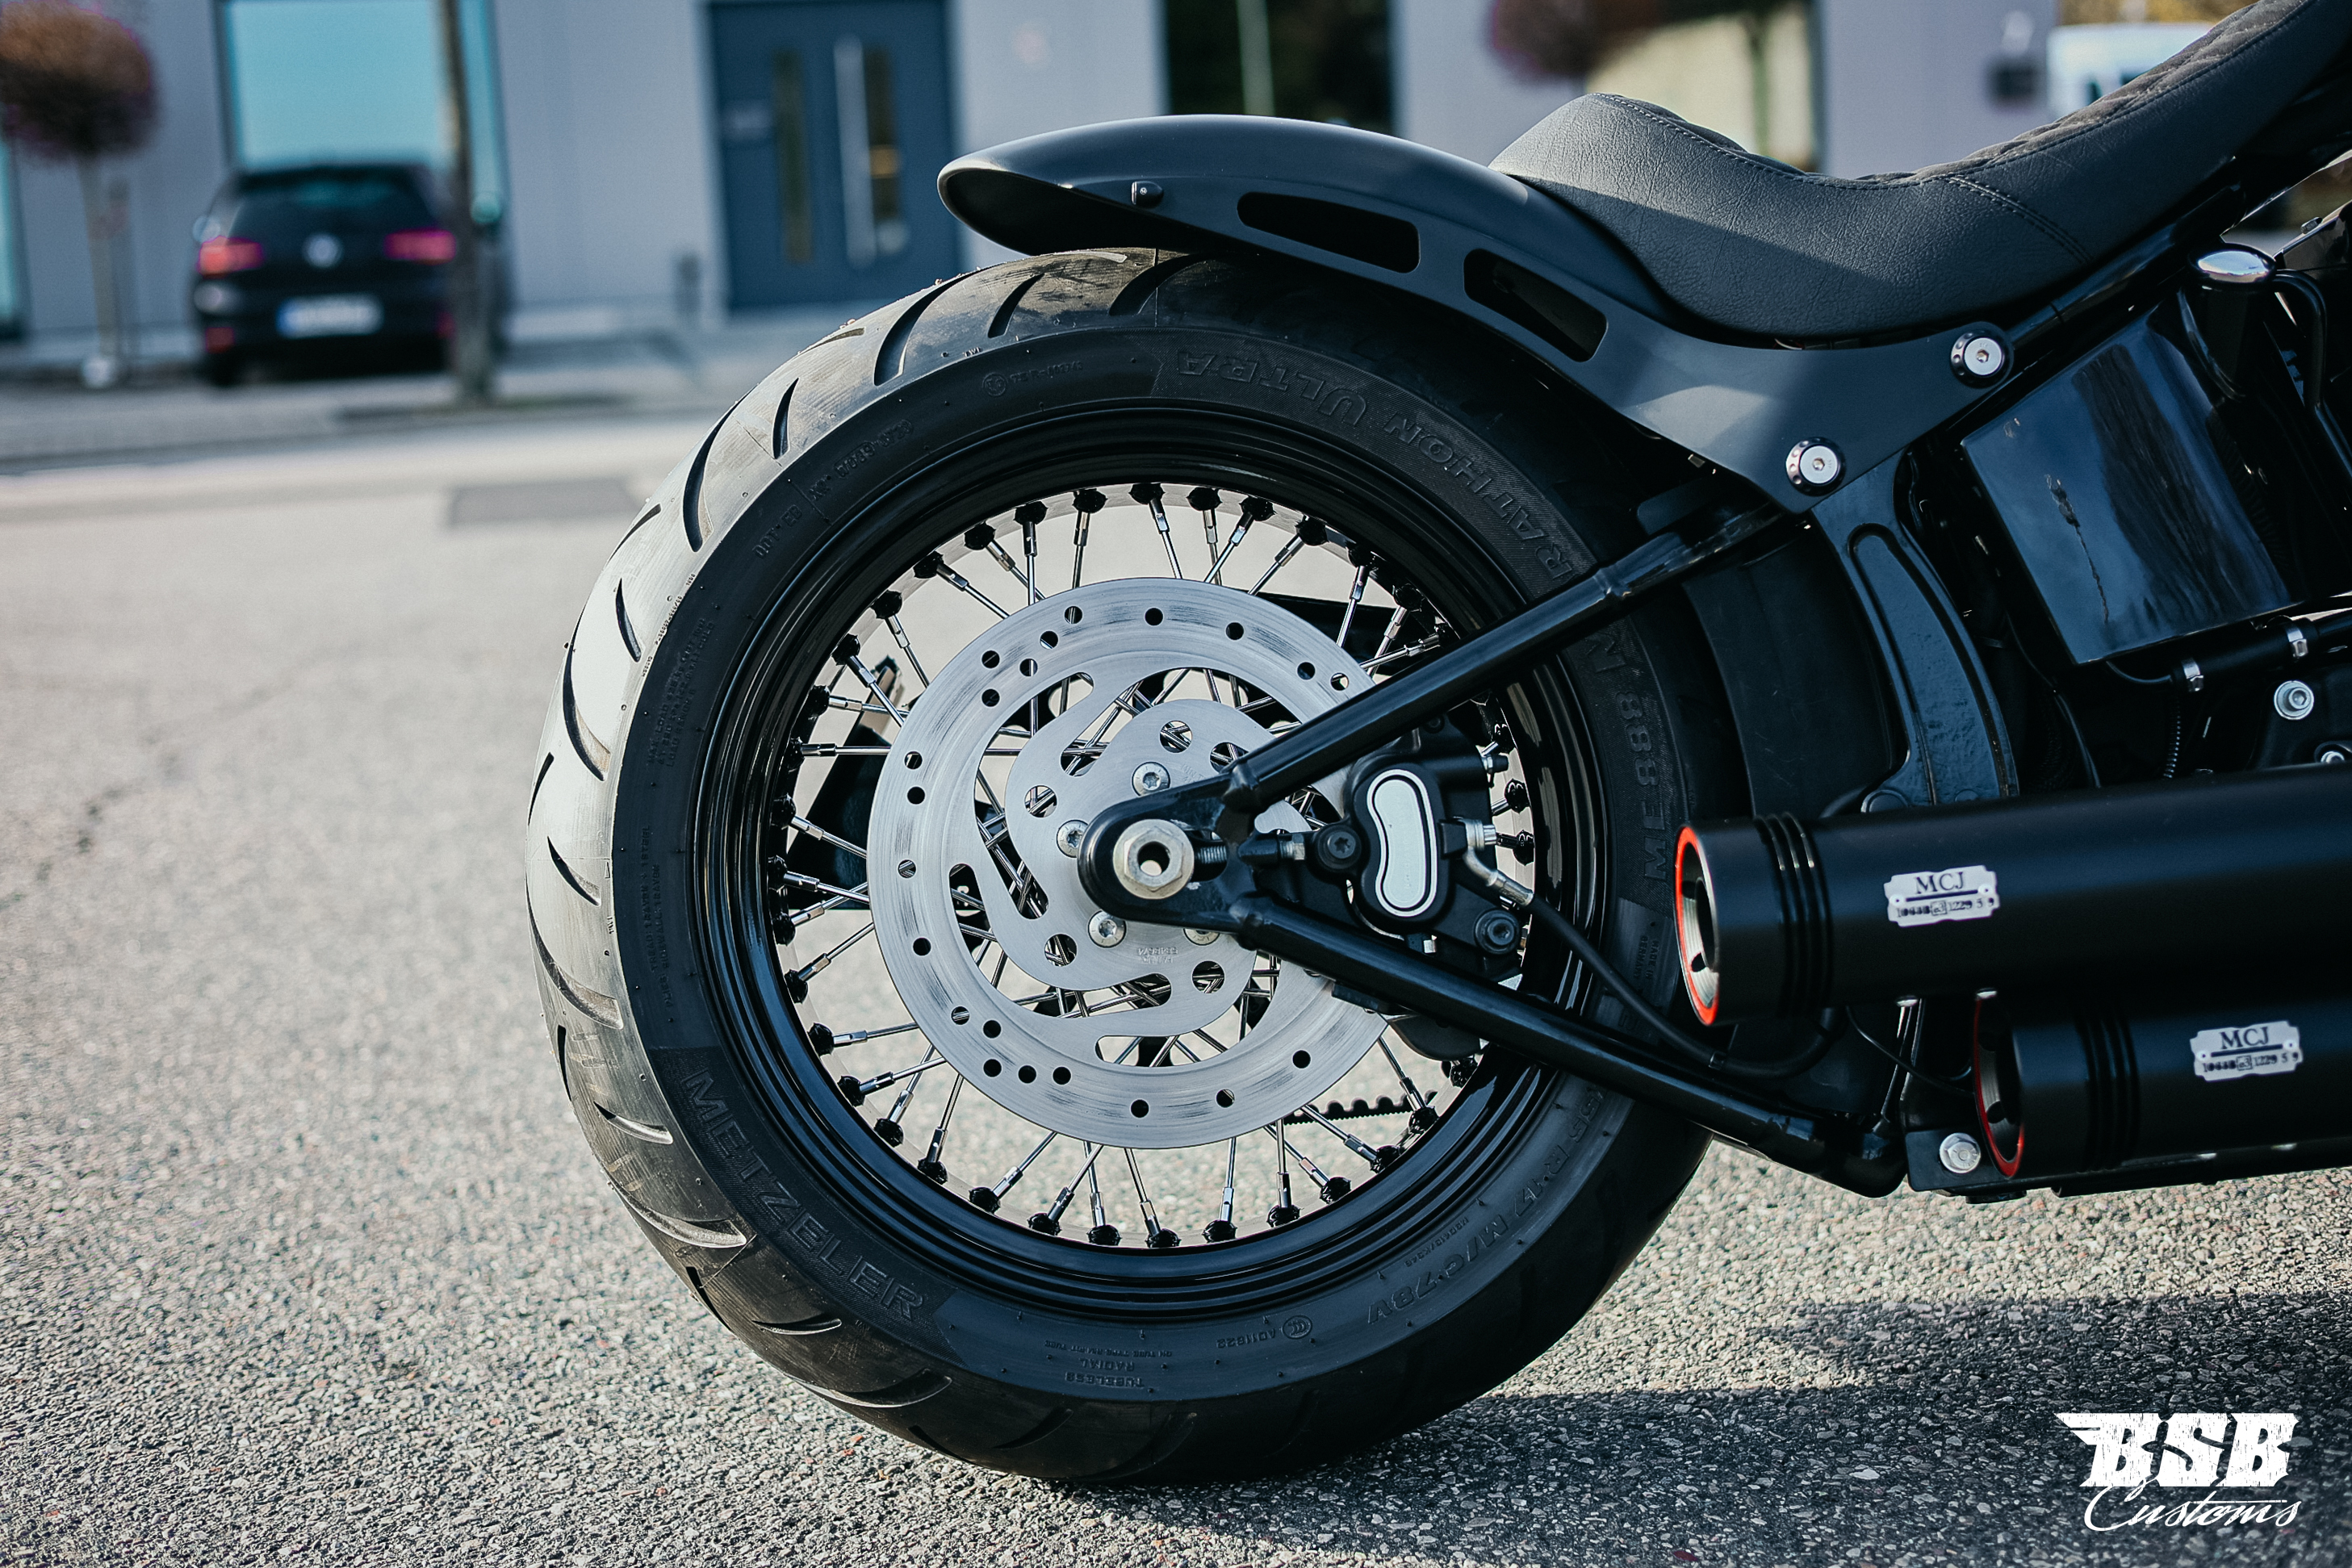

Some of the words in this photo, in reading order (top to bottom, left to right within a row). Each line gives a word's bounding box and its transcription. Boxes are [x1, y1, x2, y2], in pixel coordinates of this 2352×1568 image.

[1176, 350, 1371, 429] ULTRA
[1381, 409, 1627, 677] MRATHON
[653, 702, 671, 734] LOAD
[1612, 685, 1660, 789] 888
[665, 735, 681, 768] LOAD
[1638, 795, 1667, 880] ME
[1915, 872, 1964, 894] MCJ
[1631, 934, 1649, 979] GERMANY
[1646, 939, 1660, 970] MADE
[2220, 1027, 2270, 1049] MCJ
[1540, 1144, 1572, 1177] R
[680, 1065, 927, 1323] METZELER
[1506, 1176, 1547, 1219] 17
[1437, 1213, 1512, 1280] M/C
[1360, 1269, 1441, 1326] 78V
[1063, 1369, 1145, 1388] TUBELESS
[1077, 1356, 1135, 1372] RADIAL
